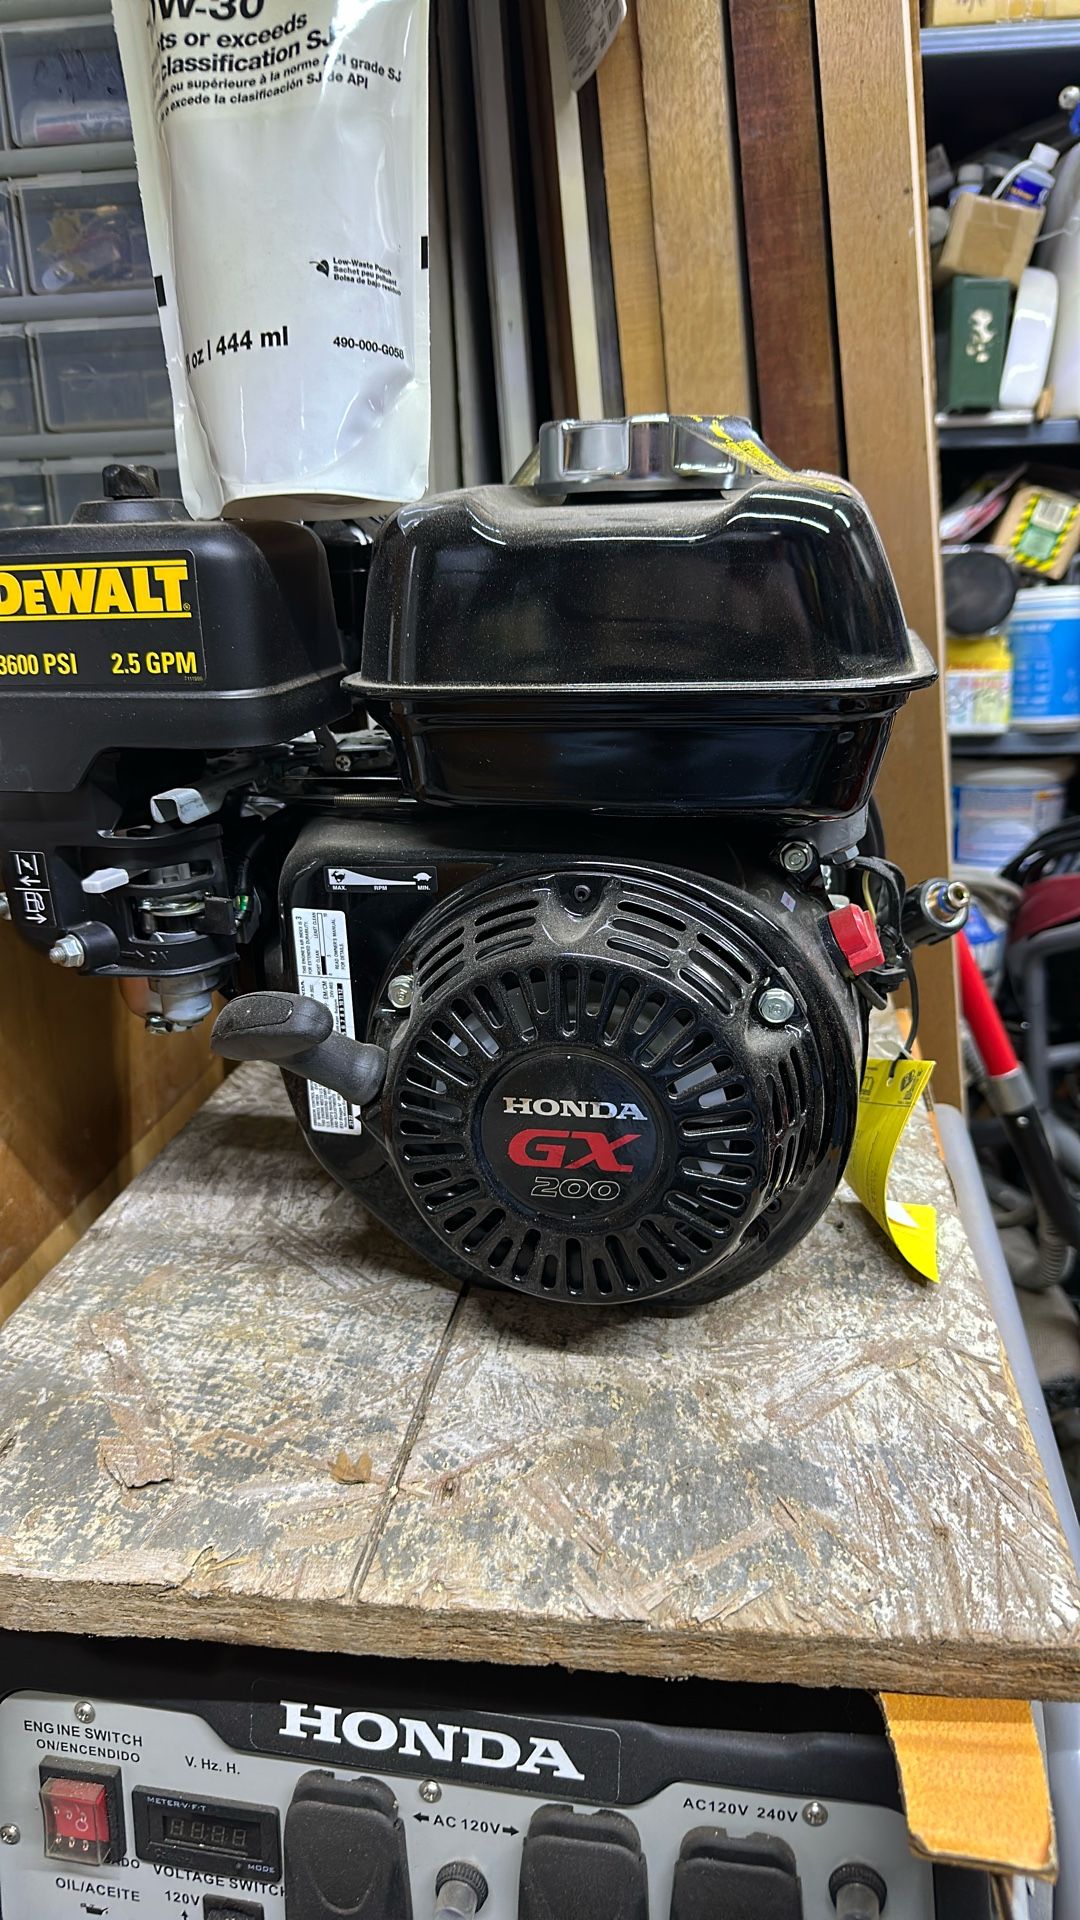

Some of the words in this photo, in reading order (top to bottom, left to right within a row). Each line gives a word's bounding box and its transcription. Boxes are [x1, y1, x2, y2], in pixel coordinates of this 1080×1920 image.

[184, 33, 210, 46] or
[217, 13, 307, 48] exceeds
[171, 82, 183, 93] ou
[270, 71, 280, 82] la
[284, 58, 320, 77] norme
[351, 58, 385, 77] grade
[388, 68, 402, 83] SJ
[170, 94, 210, 112] excede
[215, 94, 226, 104] la
[306, 72, 322, 85] SJ
[328, 71, 343, 82] de
[347, 73, 368, 89] API
[333, 257, 374, 269] Low-Waste
[333, 265, 360, 275] Sachet
[361, 270, 375, 279] peu
[333, 274, 355, 283] Bolsa
[356, 277, 366, 285] de
[192, 349, 204, 369] oz
[216, 330, 253, 355] 444
[260, 326, 288, 348] ml
[43, 652, 78, 675] PSI
[111, 652, 141, 674] 2.5
[146, 651, 197, 674] GPM
[503, 1096, 648, 1121] HONDA
[507, 1128, 642, 1173] GX
[530, 1176, 621, 1201] 200
[23, 1719, 81, 1738] ENGINE
[85, 1727, 143, 1747] SWITCH
[278, 1700, 585, 1781] HONDA
[36, 1738, 141, 1763] ON/ENCENDIDO
[184, 1755, 198, 1769] V.
[201, 1759, 223, 1773] Hz.
[226, 1762, 241, 1775] H.
[433, 1814, 457, 1828] AC
[460, 1818, 500, 1835] 120V
[757, 1807, 798, 1822] 240V
[152, 1863, 225, 1887] VOLTAGE
[247, 1863, 276, 1874] MODE
[55, 1877, 141, 1902] OIL/ACEITE
[164, 1890, 200, 1906] 120V
